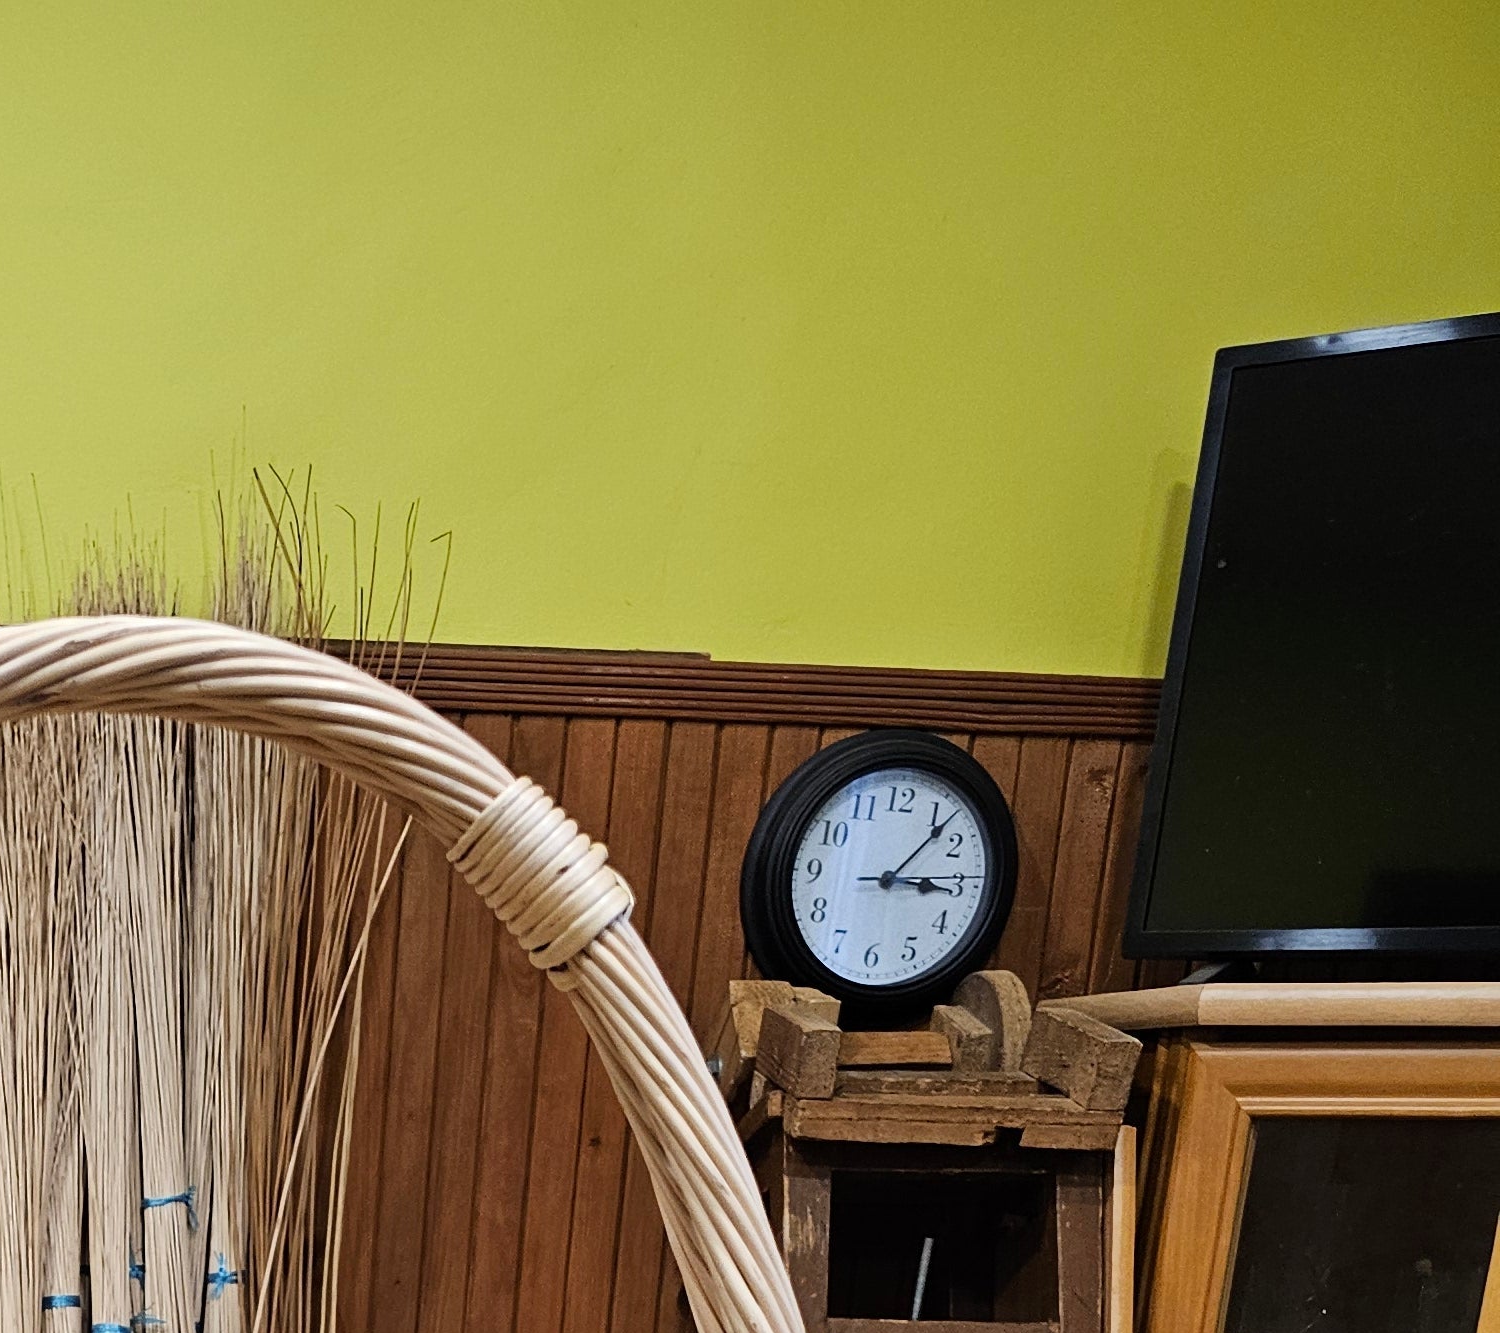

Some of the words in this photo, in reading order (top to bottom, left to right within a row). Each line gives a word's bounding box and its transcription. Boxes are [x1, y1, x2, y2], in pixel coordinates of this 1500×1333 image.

[851, 794, 876, 821] 11
[885, 786, 915, 813] 12
[927, 802, 940, 826] 1
[818, 821, 848, 847] 10
[946, 833, 963, 858] 2
[806, 858, 823, 883] 9
[949, 872, 964, 897] 3
[810, 897, 827, 923] 8
[931, 909, 948, 935] 4
[832, 929, 848, 954] 7
[901, 936, 918, 961] 5
[864, 943, 881, 968] 6
